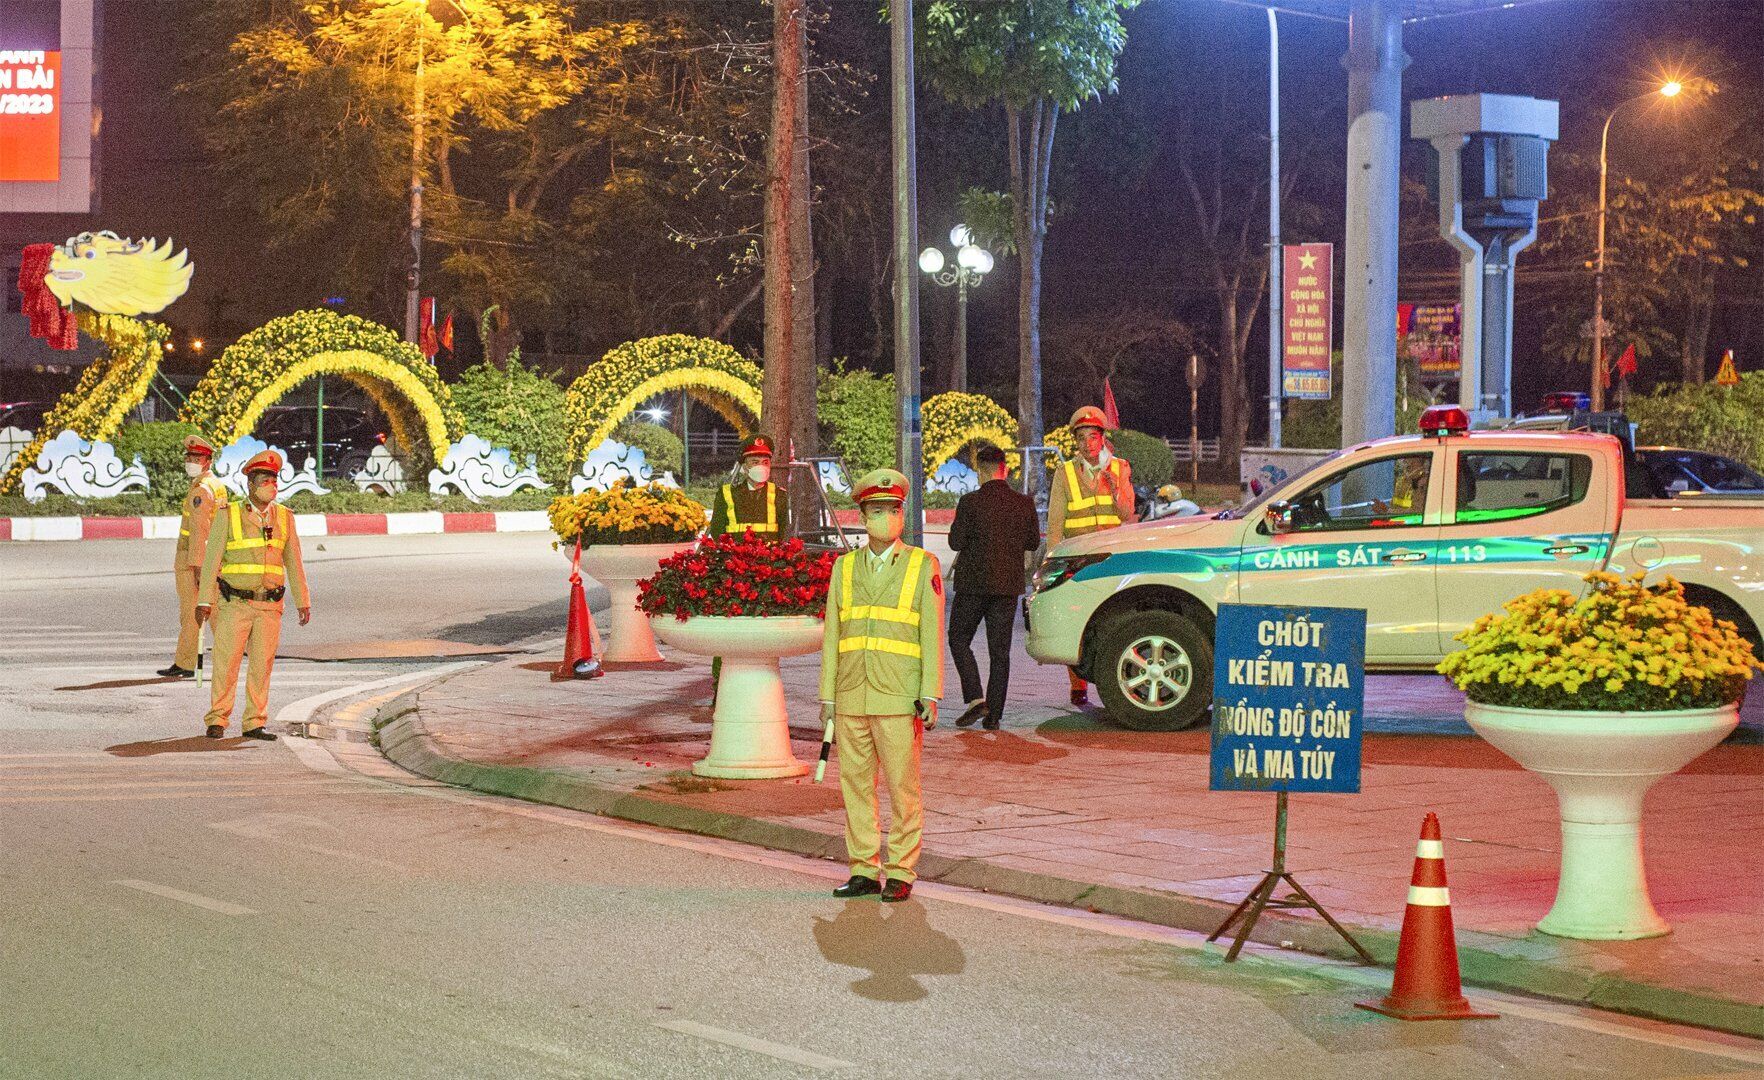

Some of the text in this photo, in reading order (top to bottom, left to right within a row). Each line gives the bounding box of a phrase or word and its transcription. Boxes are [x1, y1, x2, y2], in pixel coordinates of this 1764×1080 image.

[16, 64, 54, 89] BÀI
[1290, 289, 1309, 300] CỘNG
[1289, 315, 1304, 327] CHỦ
[1291, 332, 1324, 342] VIỆT NAM
[1287, 345, 1307, 355] MUÔN
[1254, 544, 1487, 569] CẢNH SÁT 113
[1258, 613, 1324, 647] CHỐT
[1228, 649, 1350, 688] KIỂM TRA
[1279, 702, 1306, 743] ĐỘ
[1310, 700, 1351, 739] CỒN
[1233, 743, 1336, 780] VÀ MA TÚY
